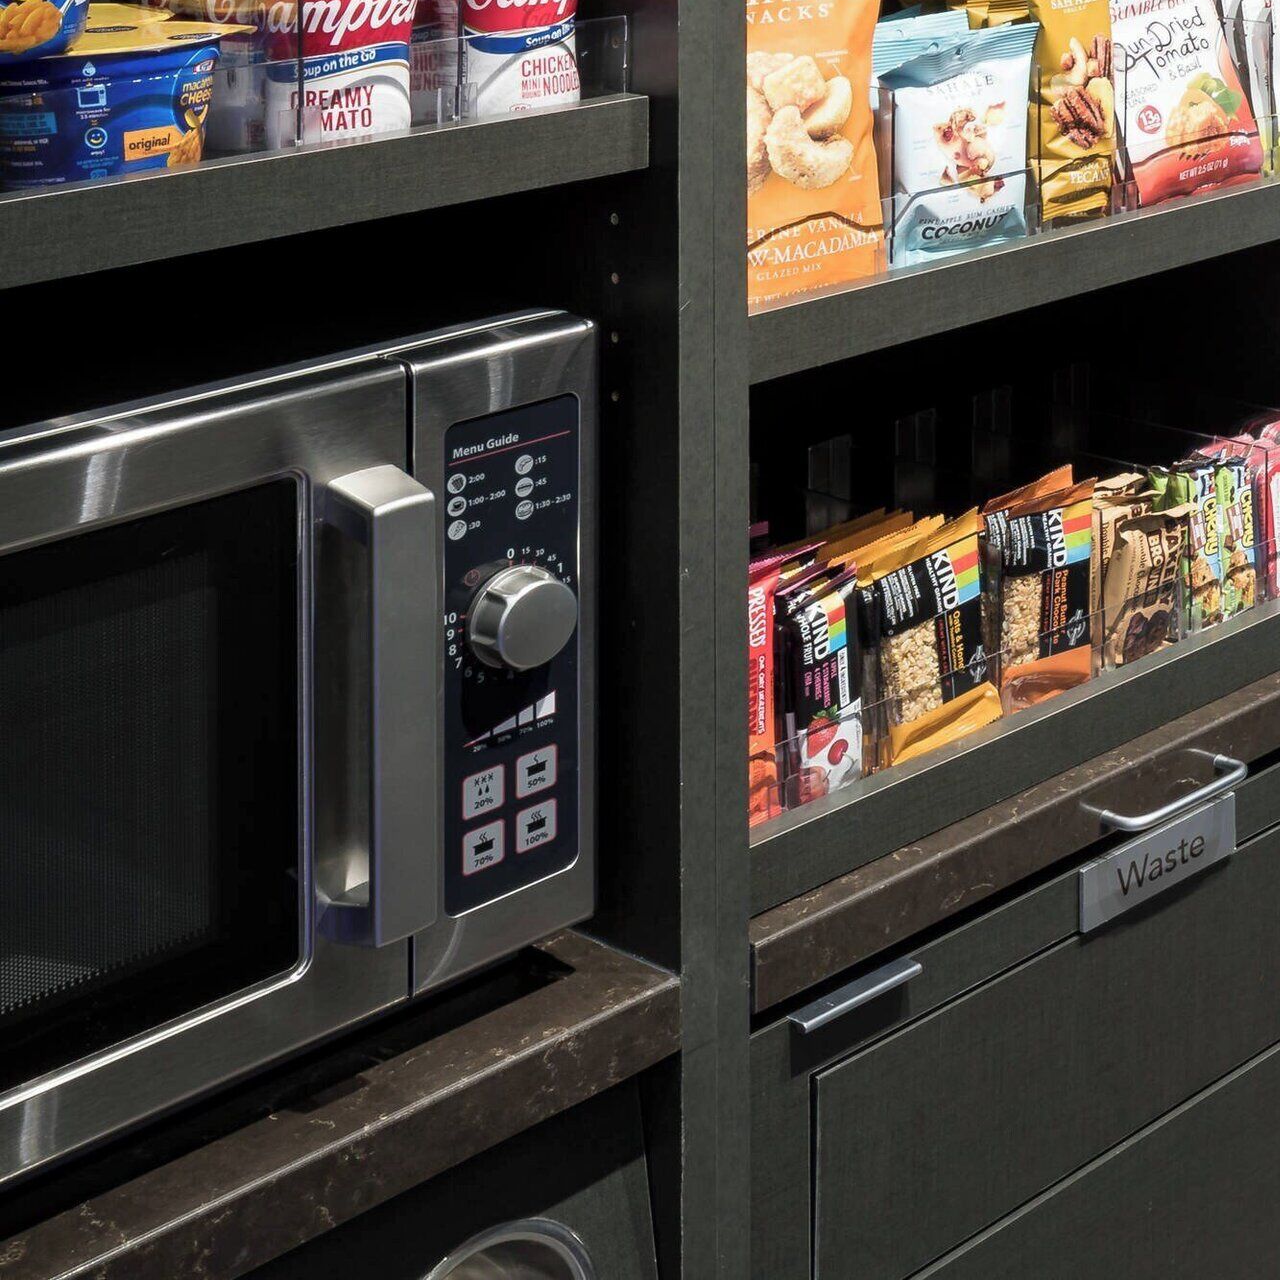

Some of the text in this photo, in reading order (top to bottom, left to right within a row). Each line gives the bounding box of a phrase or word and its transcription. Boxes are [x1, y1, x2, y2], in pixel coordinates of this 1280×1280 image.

[525, 33, 551, 48] Soup
[294, 48, 377, 79] Soup on the Go
[1139, 37, 1210, 80] Tomato
[290, 84, 374, 110] CREAMY
[128, 133, 171, 152] original
[921, 212, 1010, 241] COCONUT
[756, 262, 823, 282] GLAZED MIX
[452, 432, 520, 460] Menu Guide
[468, 472, 486, 485] 2:00
[1048, 508, 1068, 568] KIND
[506, 548, 515, 560] 0
[521, 546, 531, 555] 15
[535, 548, 545, 557] 30
[931, 549, 959, 610] KIND
[1054, 571, 1063, 595] Dark
[1060, 569, 1069, 602] Peanut
[443, 611, 457, 626] 10
[748, 586, 767, 649] PRESSED
[952, 610, 962, 630] Oats
[446, 629, 455, 642] 9
[804, 604, 831, 661] KIND
[448, 643, 457, 657] 8
[802, 643, 814, 666] FRUIT
[455, 656, 463, 670] 7
[527, 775, 546, 789] 50%
[474, 797, 494, 810] 20%
[525, 831, 549, 846] 100%
[474, 853, 494, 869] 70%
[1116, 834, 1205, 897] Waste
